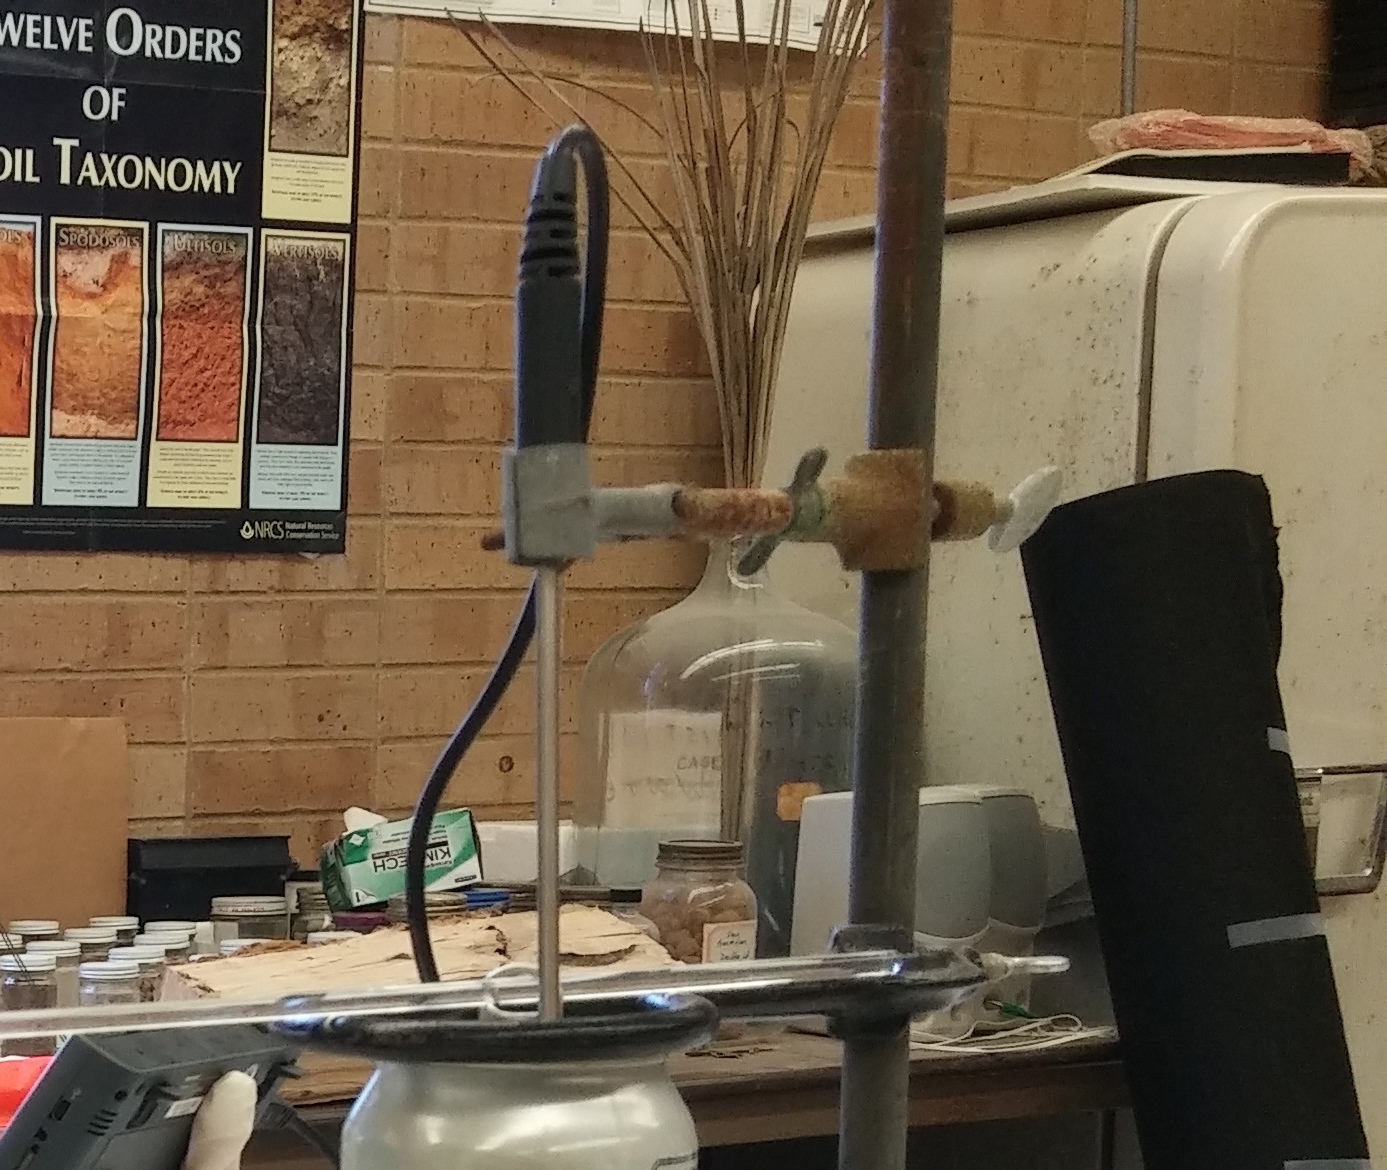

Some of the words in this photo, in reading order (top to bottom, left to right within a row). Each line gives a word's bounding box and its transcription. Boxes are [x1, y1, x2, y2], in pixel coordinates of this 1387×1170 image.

[105, 7, 242, 64] ORDERS
[82, 85, 126, 121] OF
[53, 136, 242, 194] TAXONOMY
[58, 226, 141, 249] SPODOSOLS
[254, 521, 284, 539] NRCS
